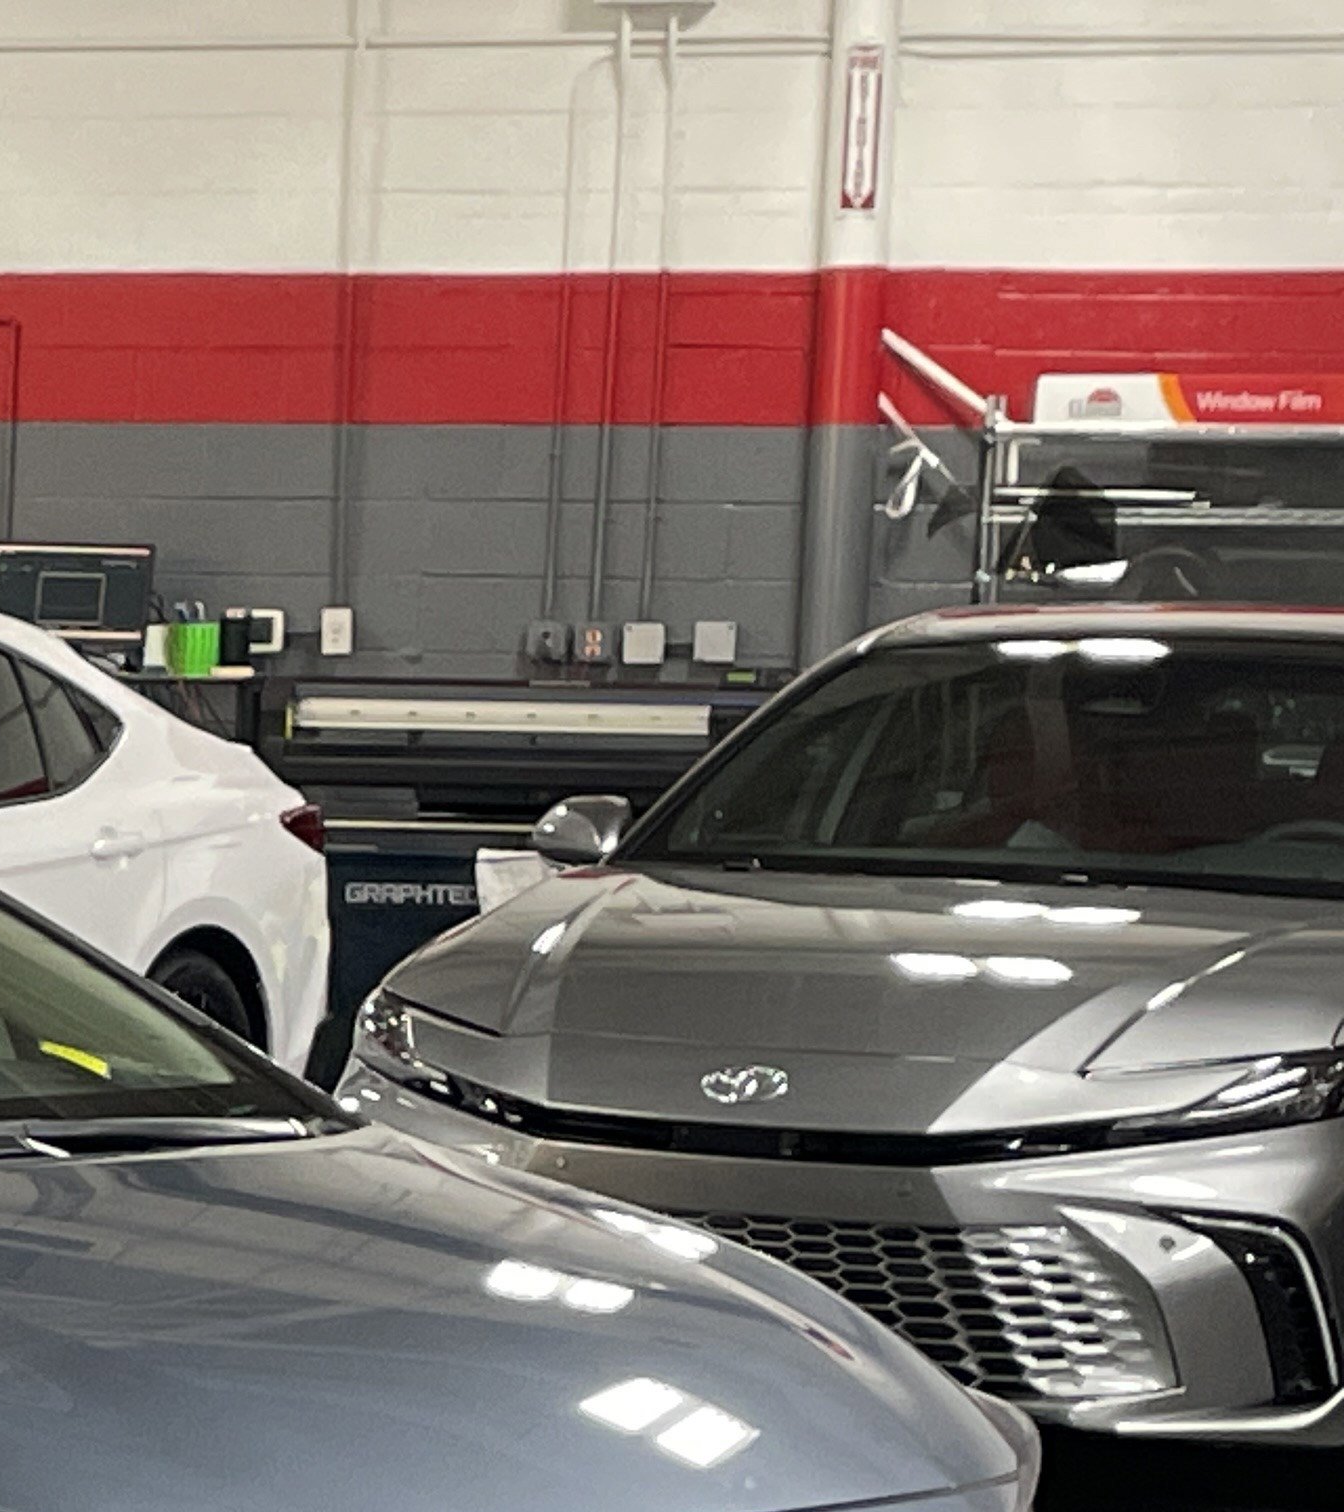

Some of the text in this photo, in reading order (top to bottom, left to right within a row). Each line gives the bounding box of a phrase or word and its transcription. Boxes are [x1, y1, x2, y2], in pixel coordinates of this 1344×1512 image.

[1196, 390, 1322, 412] Window Film
[345, 881, 477, 906] GRAPHTEC
